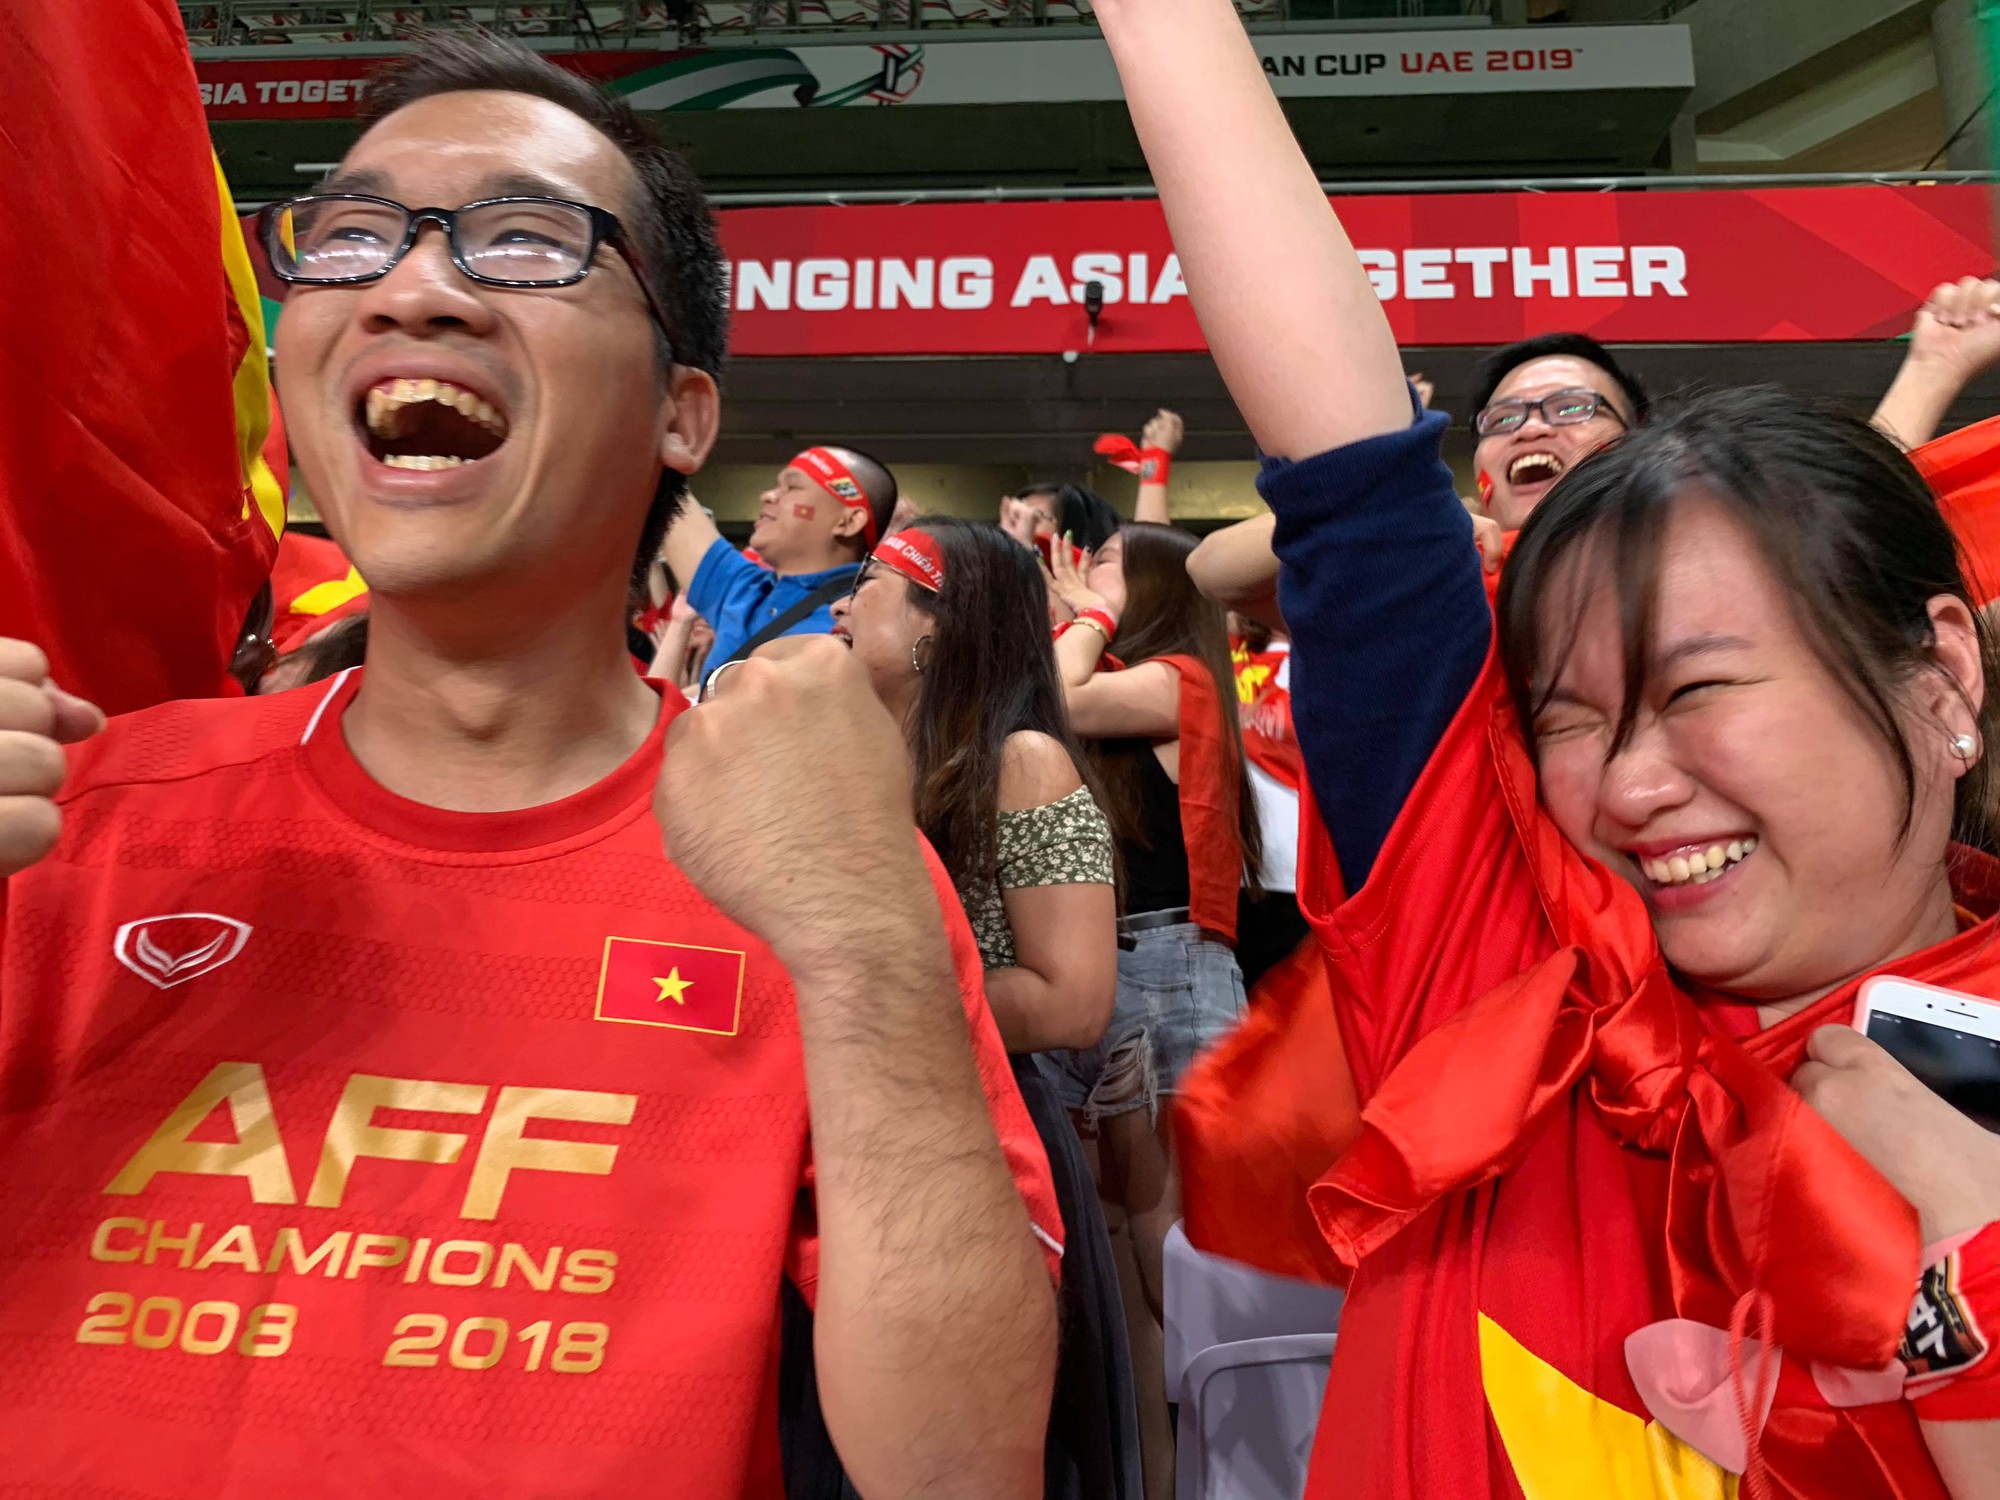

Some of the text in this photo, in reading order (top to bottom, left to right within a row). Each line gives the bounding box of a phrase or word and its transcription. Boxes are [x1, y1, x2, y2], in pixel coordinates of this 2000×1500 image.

[1316, 53, 1386, 76] CUP
[1400, 50, 1474, 74] UAE
[1011, 252, 1189, 308] ASIA
[102, 1061, 639, 1221] AFF
[90, 1215, 620, 1295] CHAMPIONS
[75, 1291, 610, 1374] 2008 2018
